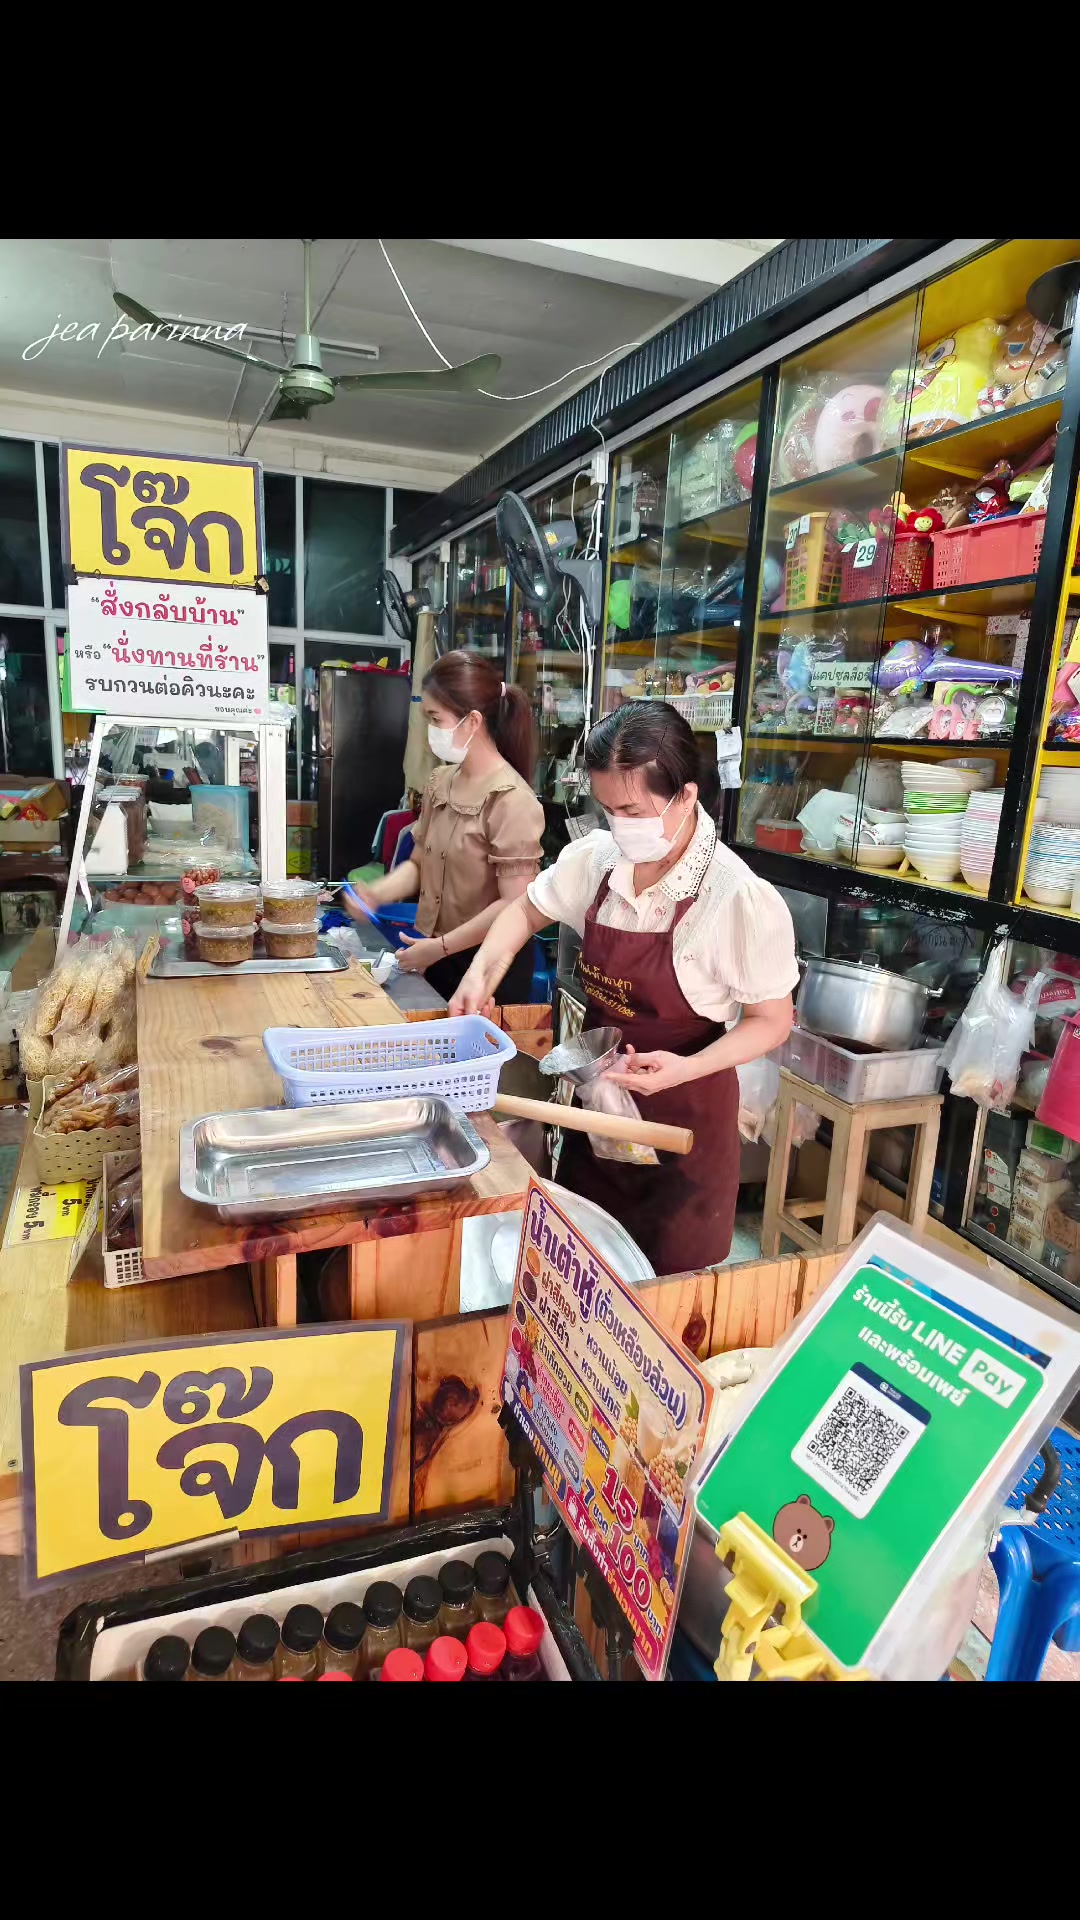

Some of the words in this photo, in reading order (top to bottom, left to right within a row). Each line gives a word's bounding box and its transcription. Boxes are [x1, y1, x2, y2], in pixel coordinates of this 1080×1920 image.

[80, 463, 244, 575] โจ๊ก
[857, 544, 875, 562] 29
[74, 644, 101, 660] หรือ
[85, 675, 255, 700] รบกวนต่อคิวนะคะ
[530, 1197, 599, 1322] น้ำเต้าหู้
[539, 1297, 570, 1350] ฝาสีดำ
[581, 1358, 621, 1421] หวานปกติ
[541, 1271, 576, 1327] ฝาสีทอง
[587, 1333, 628, 1397] หวานน้อย
[853, 1284, 914, 1332] ร้านนี้รับ
[911, 1320, 967, 1367] LINE
[971, 1360, 1014, 1395] Pay
[857, 1326, 972, 1407] และพร้อมเพย์
[58, 1366, 364, 1540] โจ๊ก
[583, 1478, 595, 1507] 7
[592, 1503, 609, 1538] ขวด
[607, 1522, 652, 1610] 100
[647, 1608, 663, 1640] บาท
[602, 1464, 637, 1532] 15
[633, 1534, 649, 1565] บาท
